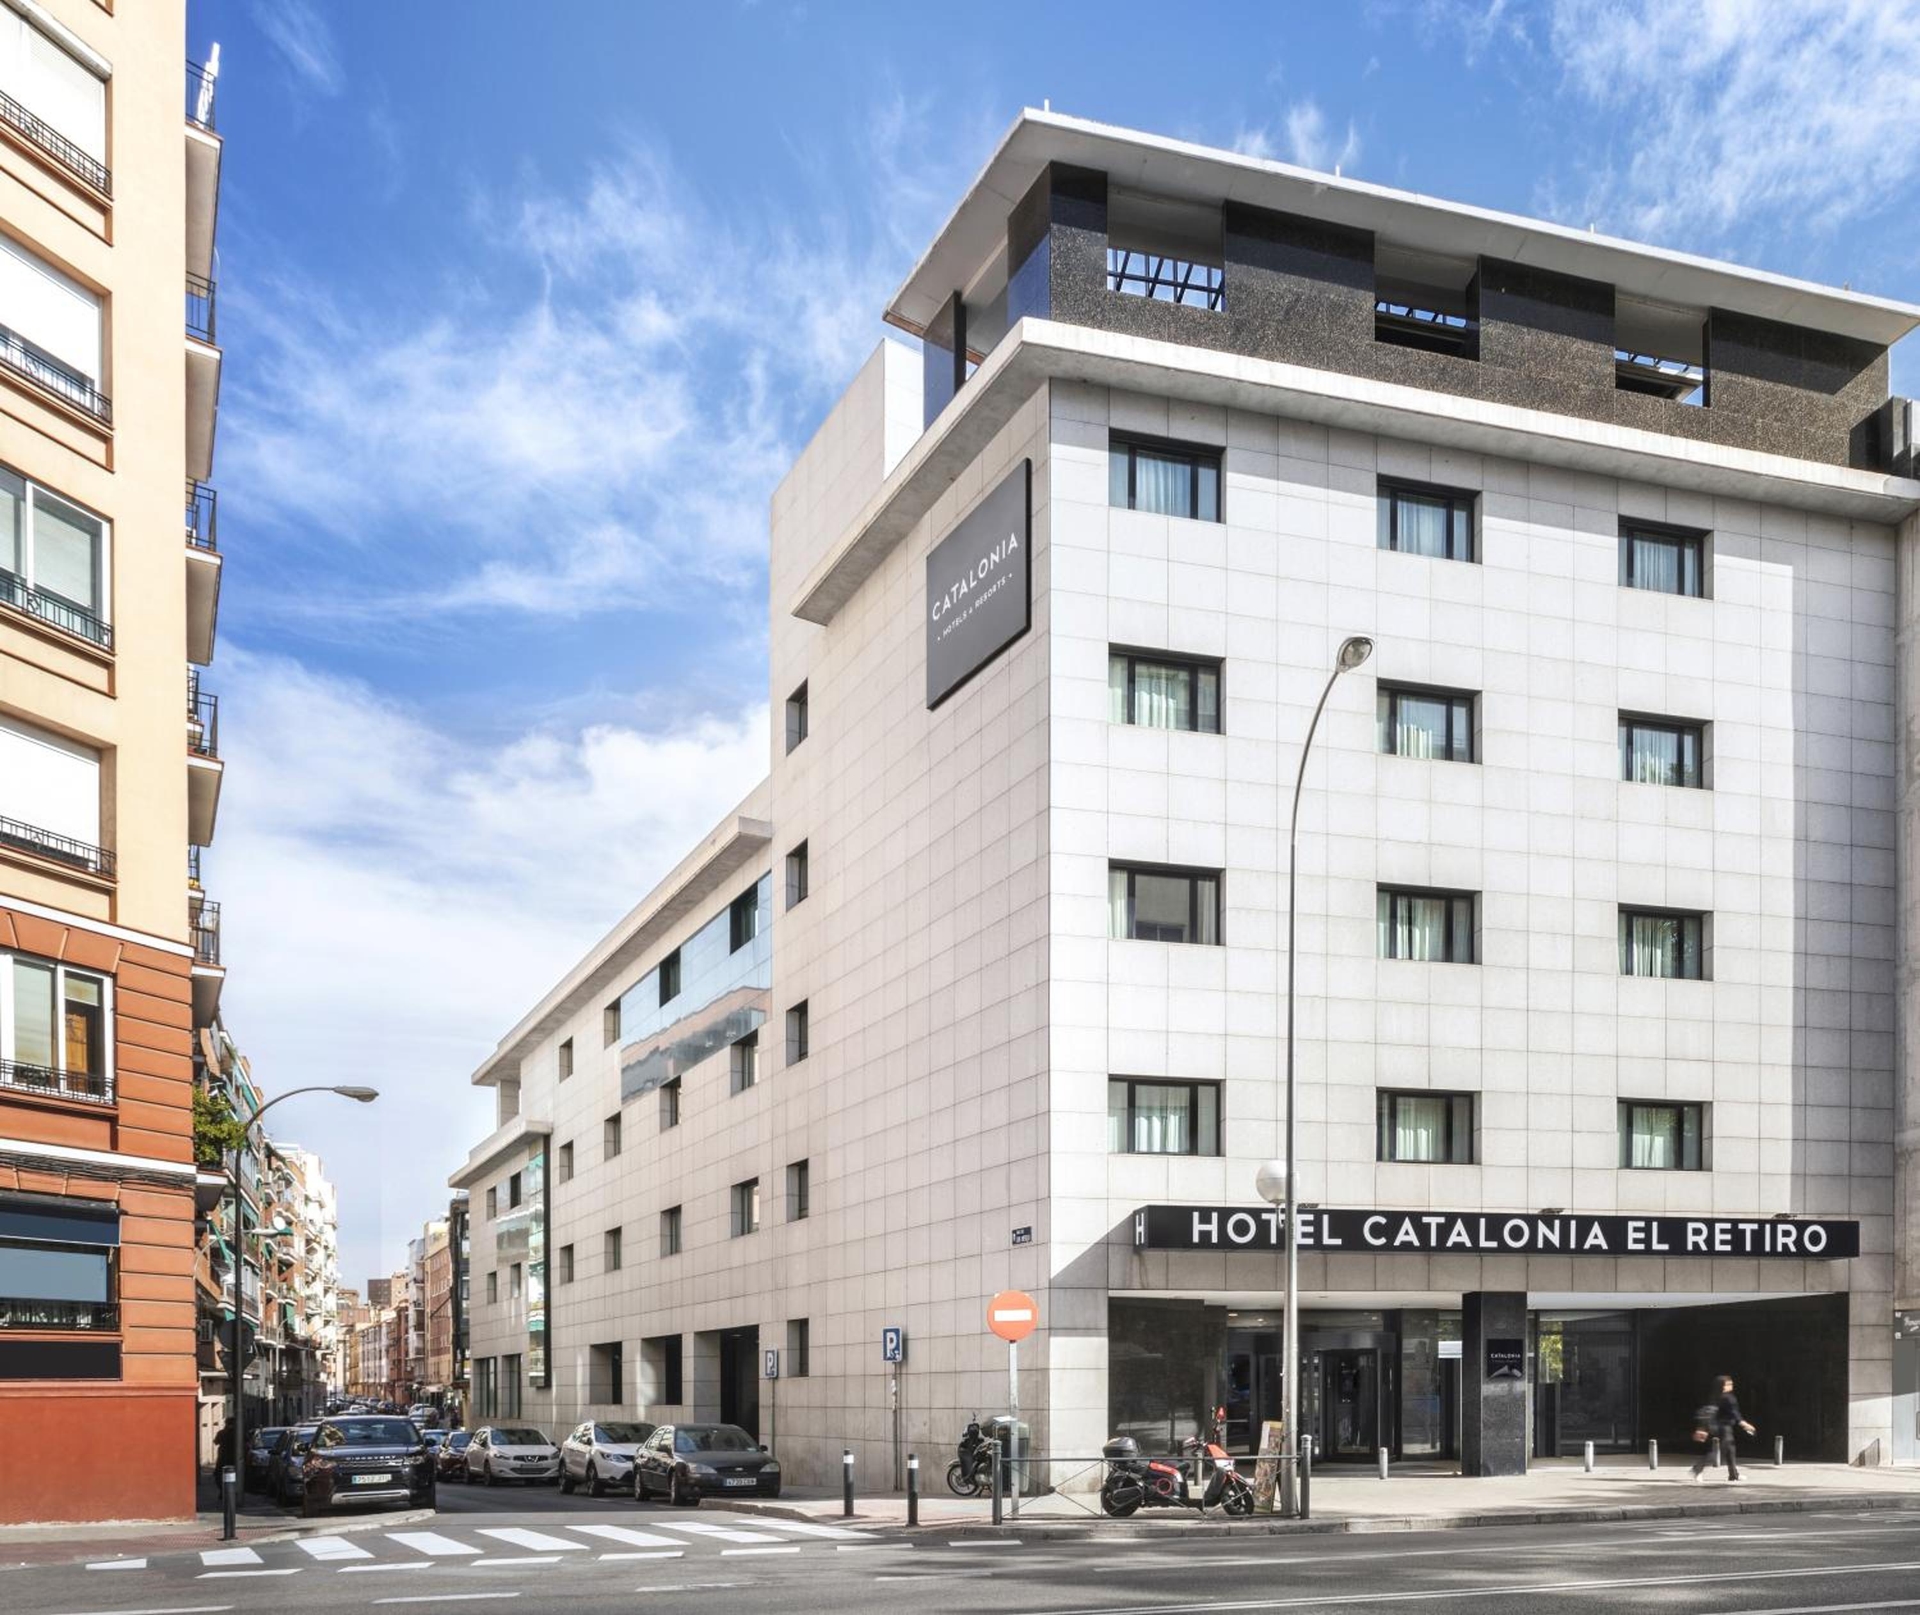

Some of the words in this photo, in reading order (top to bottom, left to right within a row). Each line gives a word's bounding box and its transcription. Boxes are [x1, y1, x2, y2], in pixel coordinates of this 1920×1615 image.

[932, 532, 1019, 621] CATALONIA
[943, 610, 967, 638] HOTELS
[975, 576, 1006, 609] RESORTS
[1192, 1211, 1342, 1245] HOTEL
[1363, 1214, 1609, 1250] CATALONIA
[1627, 1220, 1669, 1250] EL
[1686, 1221, 1828, 1253] RETIRO
[886, 1331, 897, 1357] P
